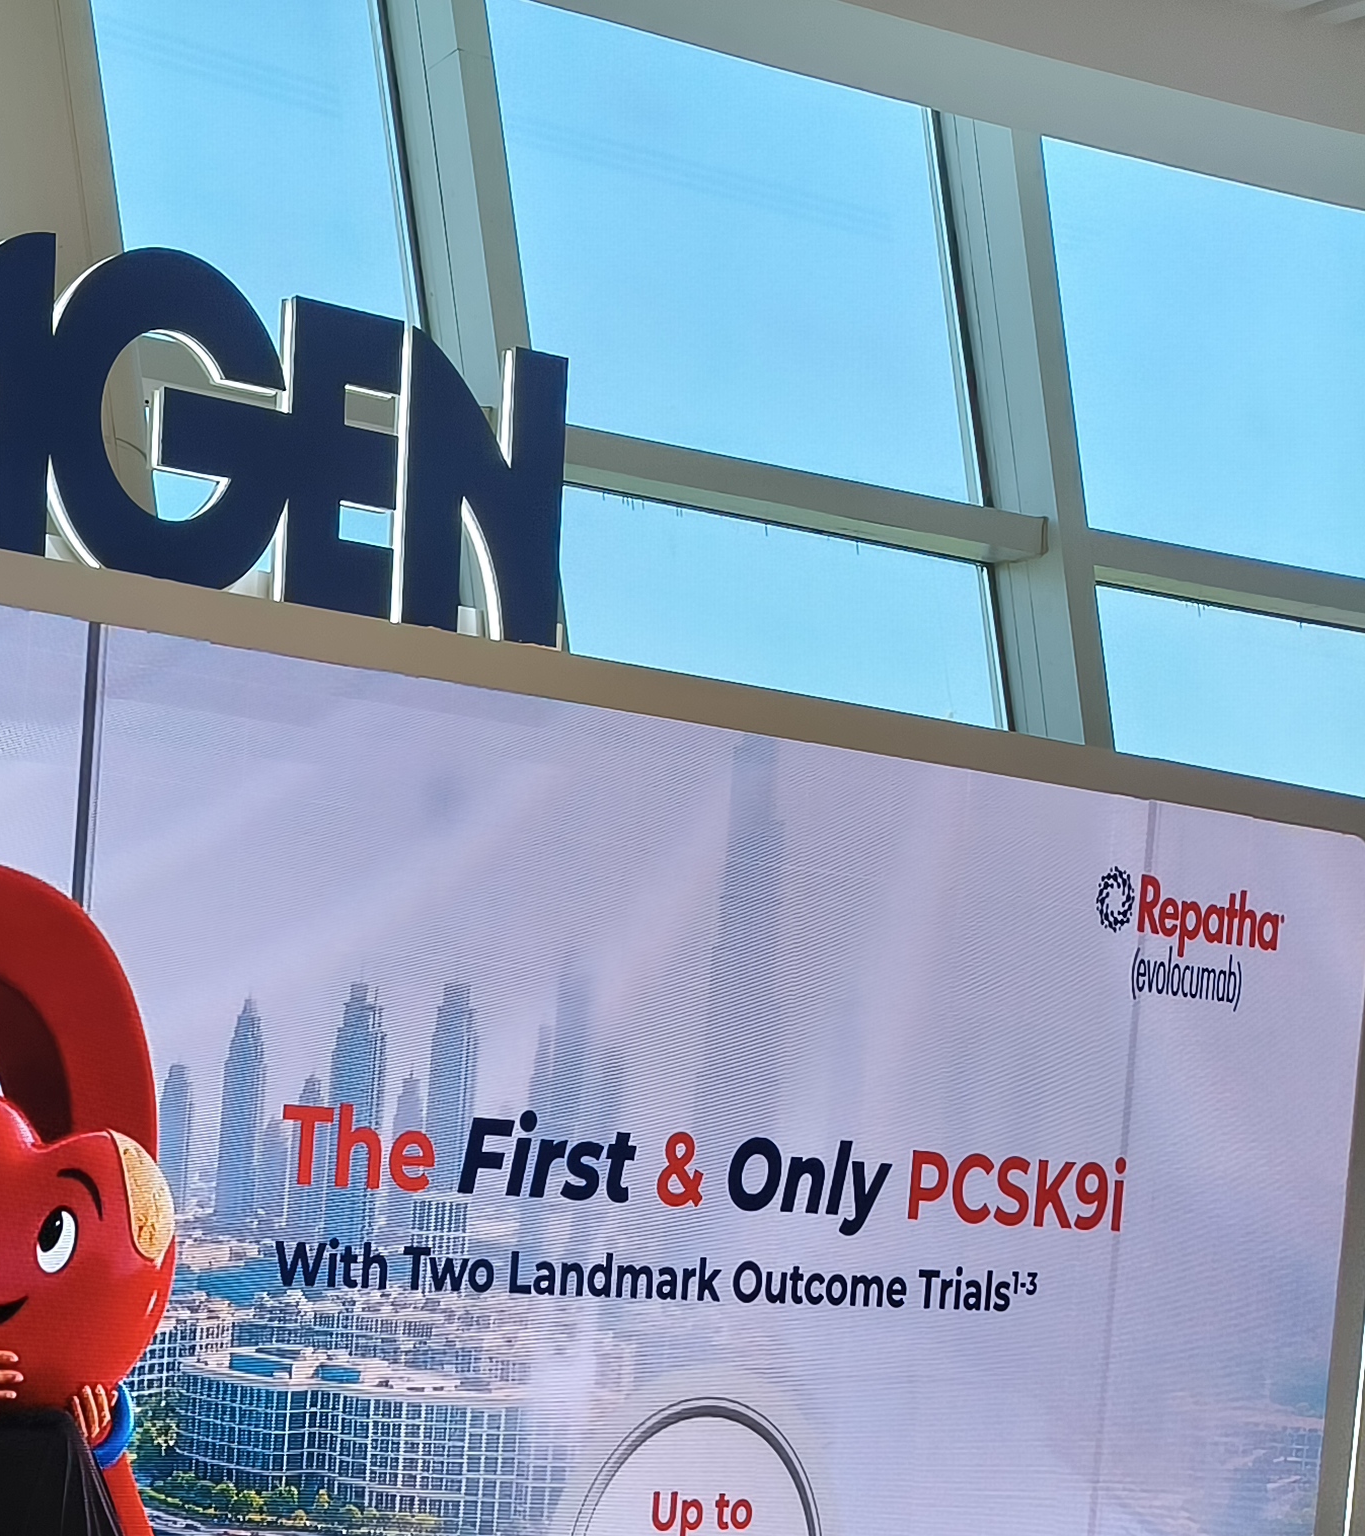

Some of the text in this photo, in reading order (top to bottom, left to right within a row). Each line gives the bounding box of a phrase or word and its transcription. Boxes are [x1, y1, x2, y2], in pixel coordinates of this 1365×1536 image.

[1136, 873, 1283, 958] Repatha
[1131, 946, 1243, 1012] (evolocumab)
[281, 1102, 1128, 1237] The First & Only PCSK9i
[275, 1238, 390, 1292] With
[403, 1247, 496, 1294] Two
[508, 1251, 721, 1304] Landmark
[732, 1260, 908, 1310] Outcome
[715, 1493, 752, 1530] to
